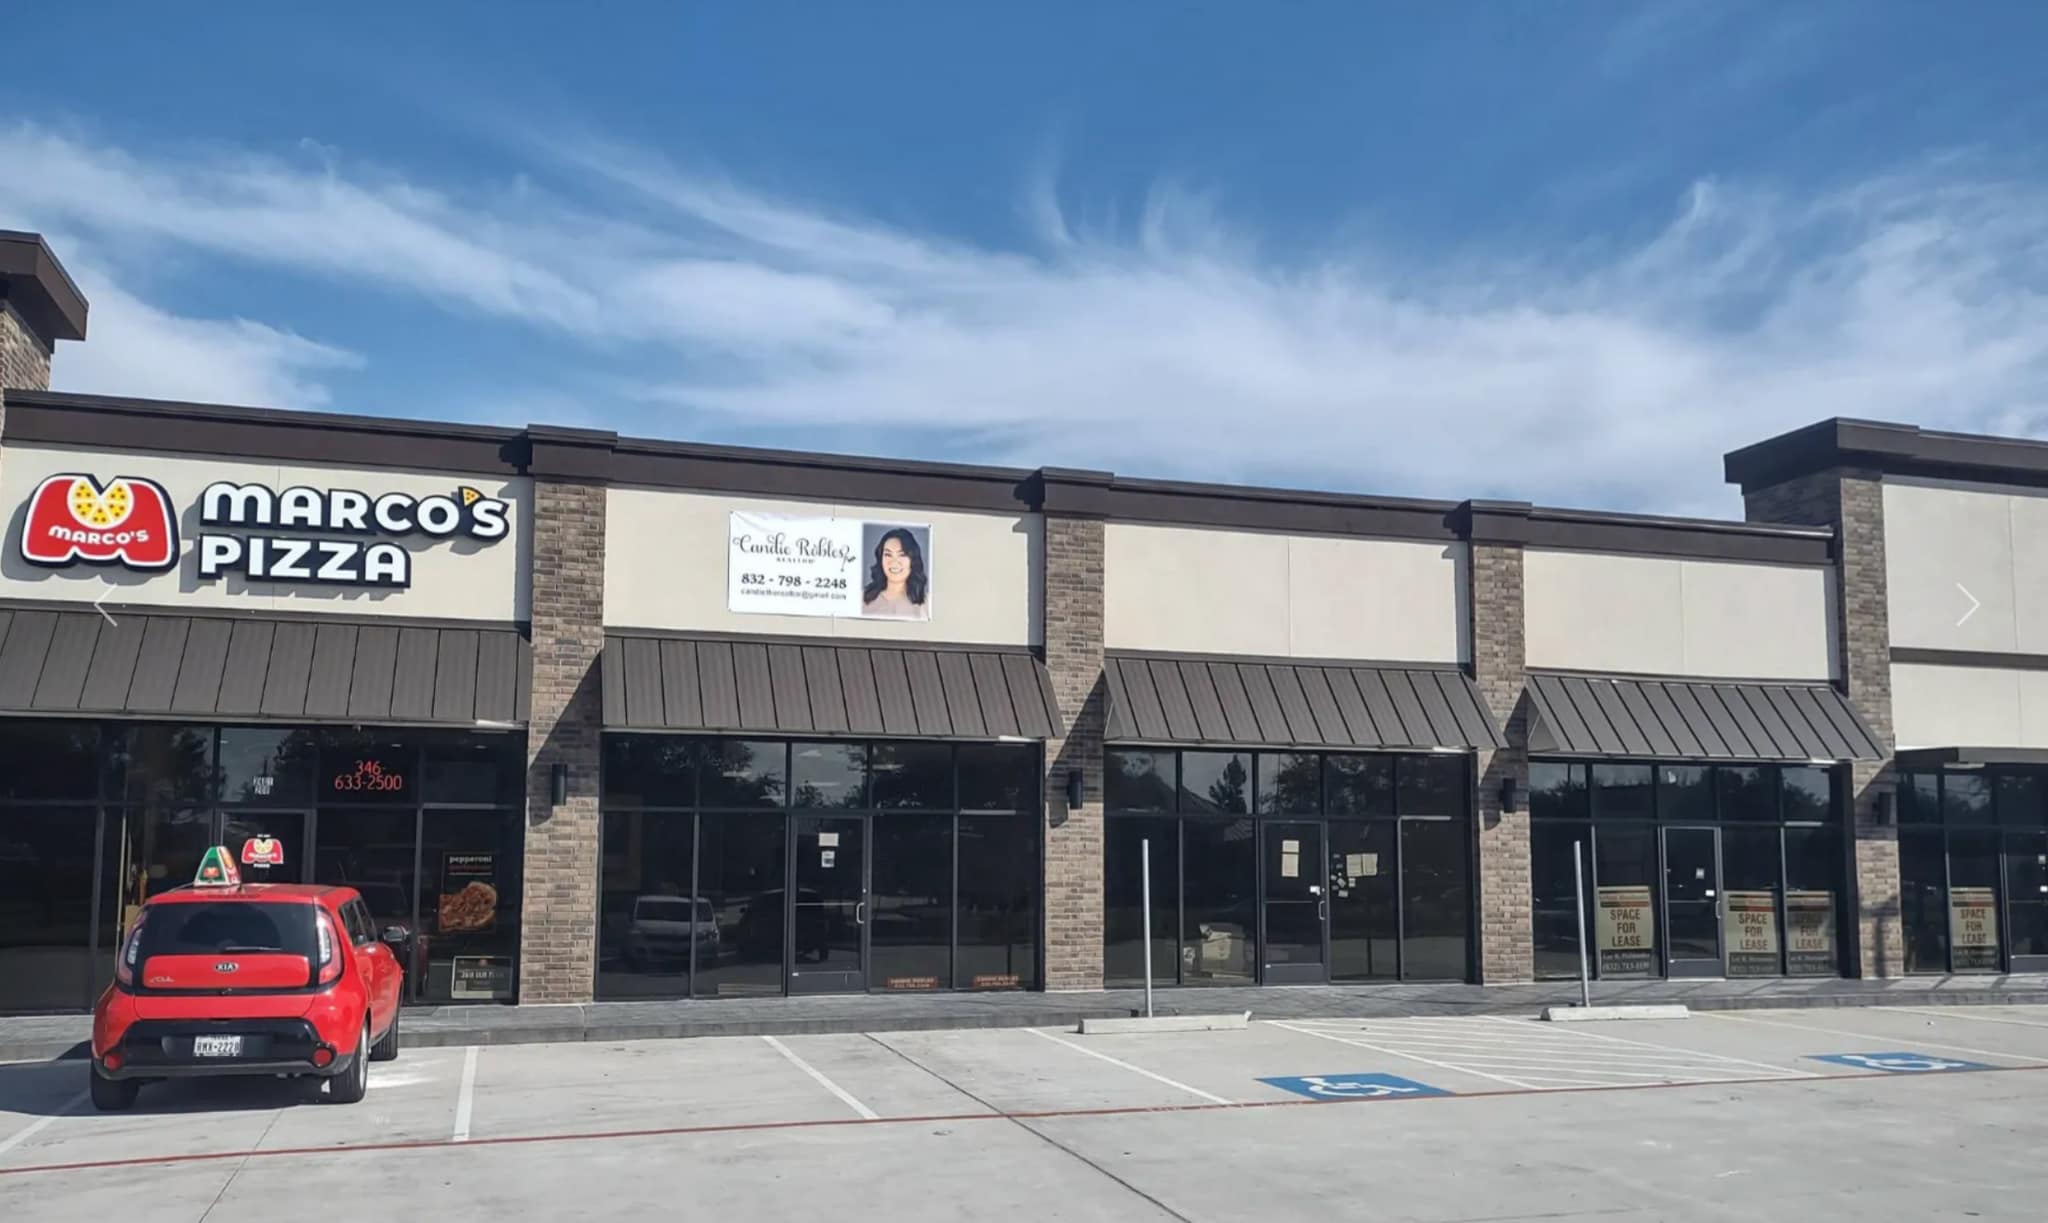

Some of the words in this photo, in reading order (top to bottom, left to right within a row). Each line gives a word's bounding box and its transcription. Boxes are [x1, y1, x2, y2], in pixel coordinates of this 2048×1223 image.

[202, 482, 509, 538] MARCO'S
[48, 525, 149, 545] MARCO'S
[732, 532, 791, 556] Candie
[795, 536, 850, 562] Robles
[201, 536, 407, 584] PIZZA
[741, 573, 765, 585] 832
[778, 575, 802, 587] 798
[815, 577, 847, 589] 2248
[334, 775, 403, 790] 633-2500
[1609, 908, 1641, 921] SPACE
[1738, 913, 1768, 925] SPACE
[1959, 908, 1986, 920] SPACE
[1616, 922, 1636, 934] FOR
[1745, 926, 1763, 937] FOR
[1966, 921, 1983, 932] FOR
[1611, 936, 1641, 948] LEASE
[1740, 939, 1768, 951] LEASE
[1795, 939, 1823, 950] LEASE
[1961, 933, 1987, 945] LEASE
